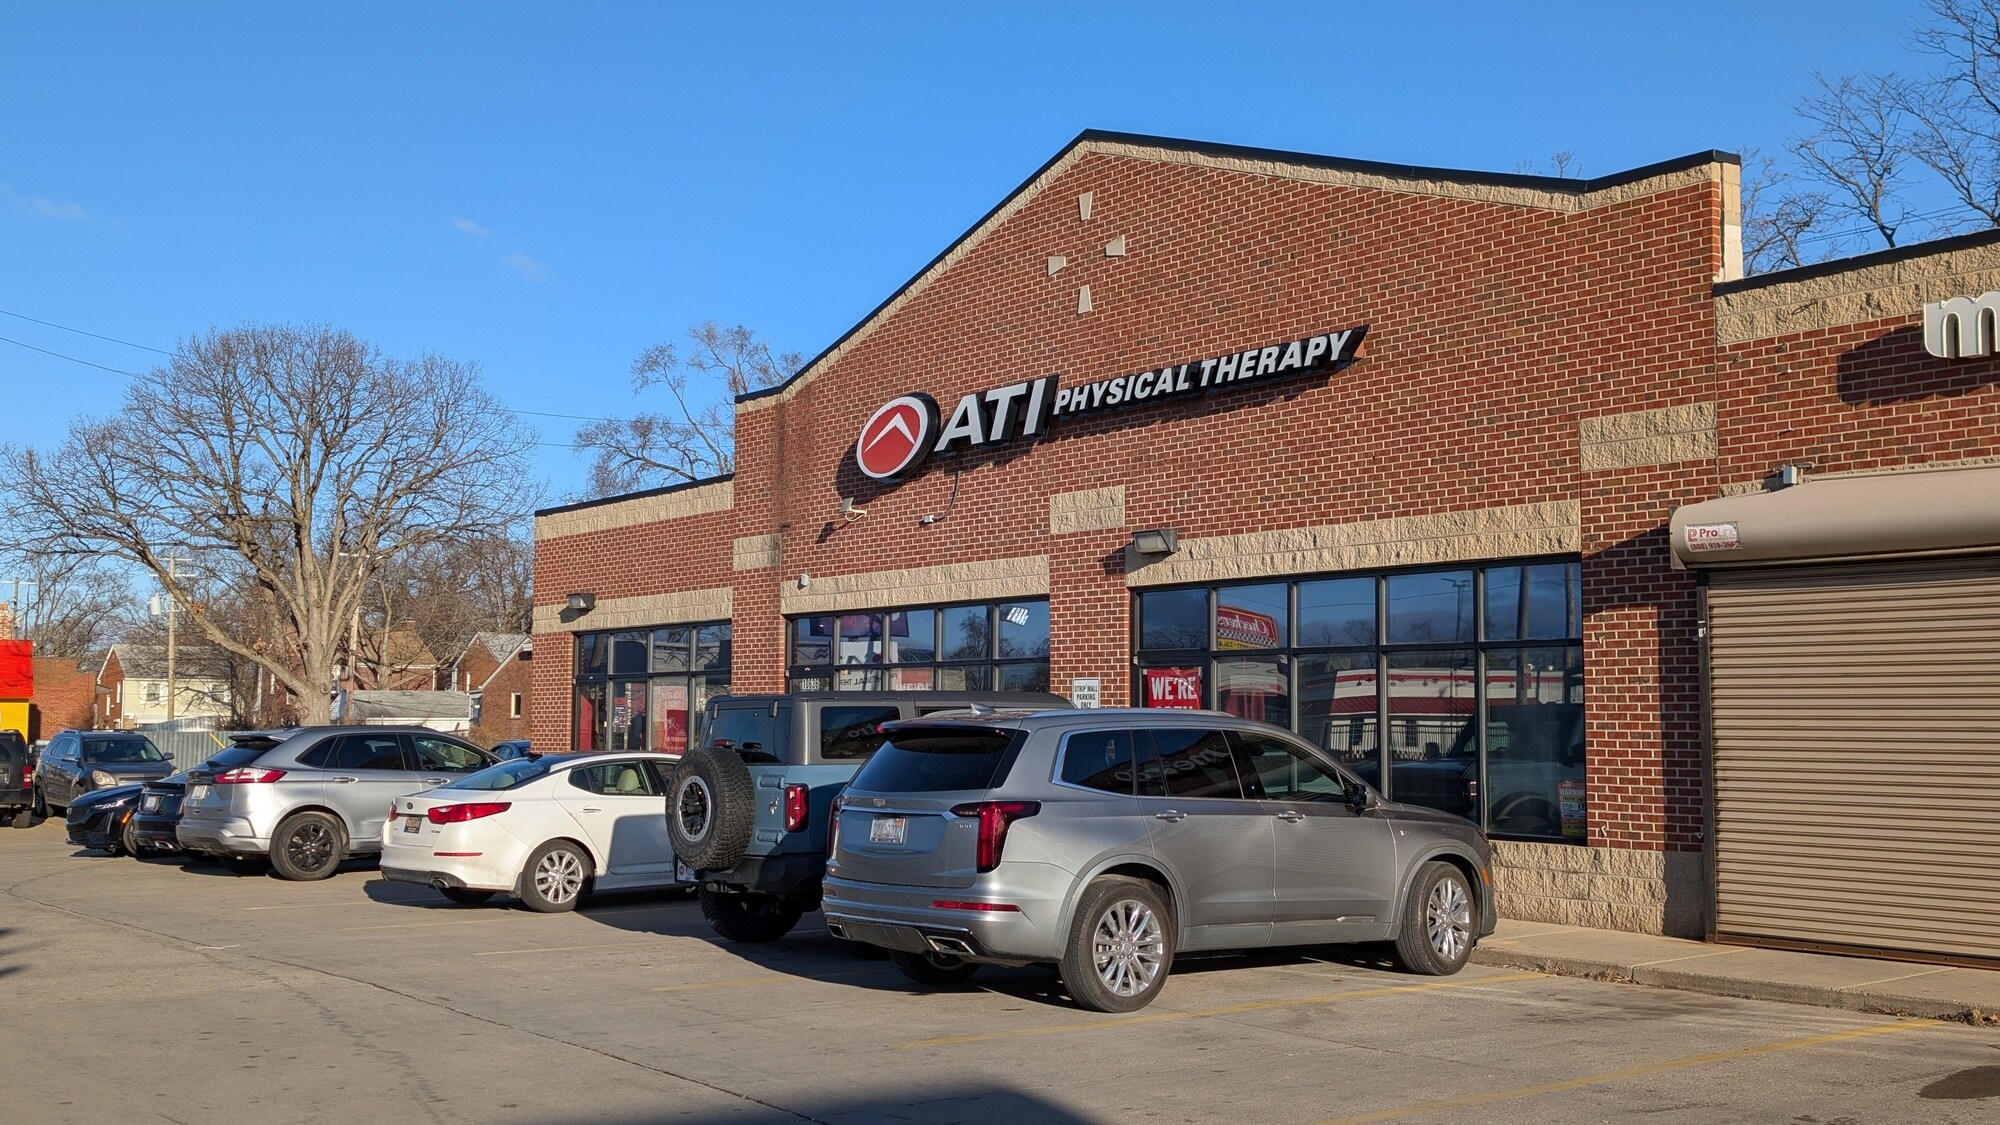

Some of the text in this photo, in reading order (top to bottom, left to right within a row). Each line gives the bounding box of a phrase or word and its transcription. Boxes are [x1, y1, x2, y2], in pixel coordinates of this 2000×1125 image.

[1923, 291, 2000, 358] m
[935, 329, 1353, 452] ATI PHYSICAL THERAPY
[1081, 701, 1092, 709] ONLY
[1151, 676, 1196, 700] WE'RE
